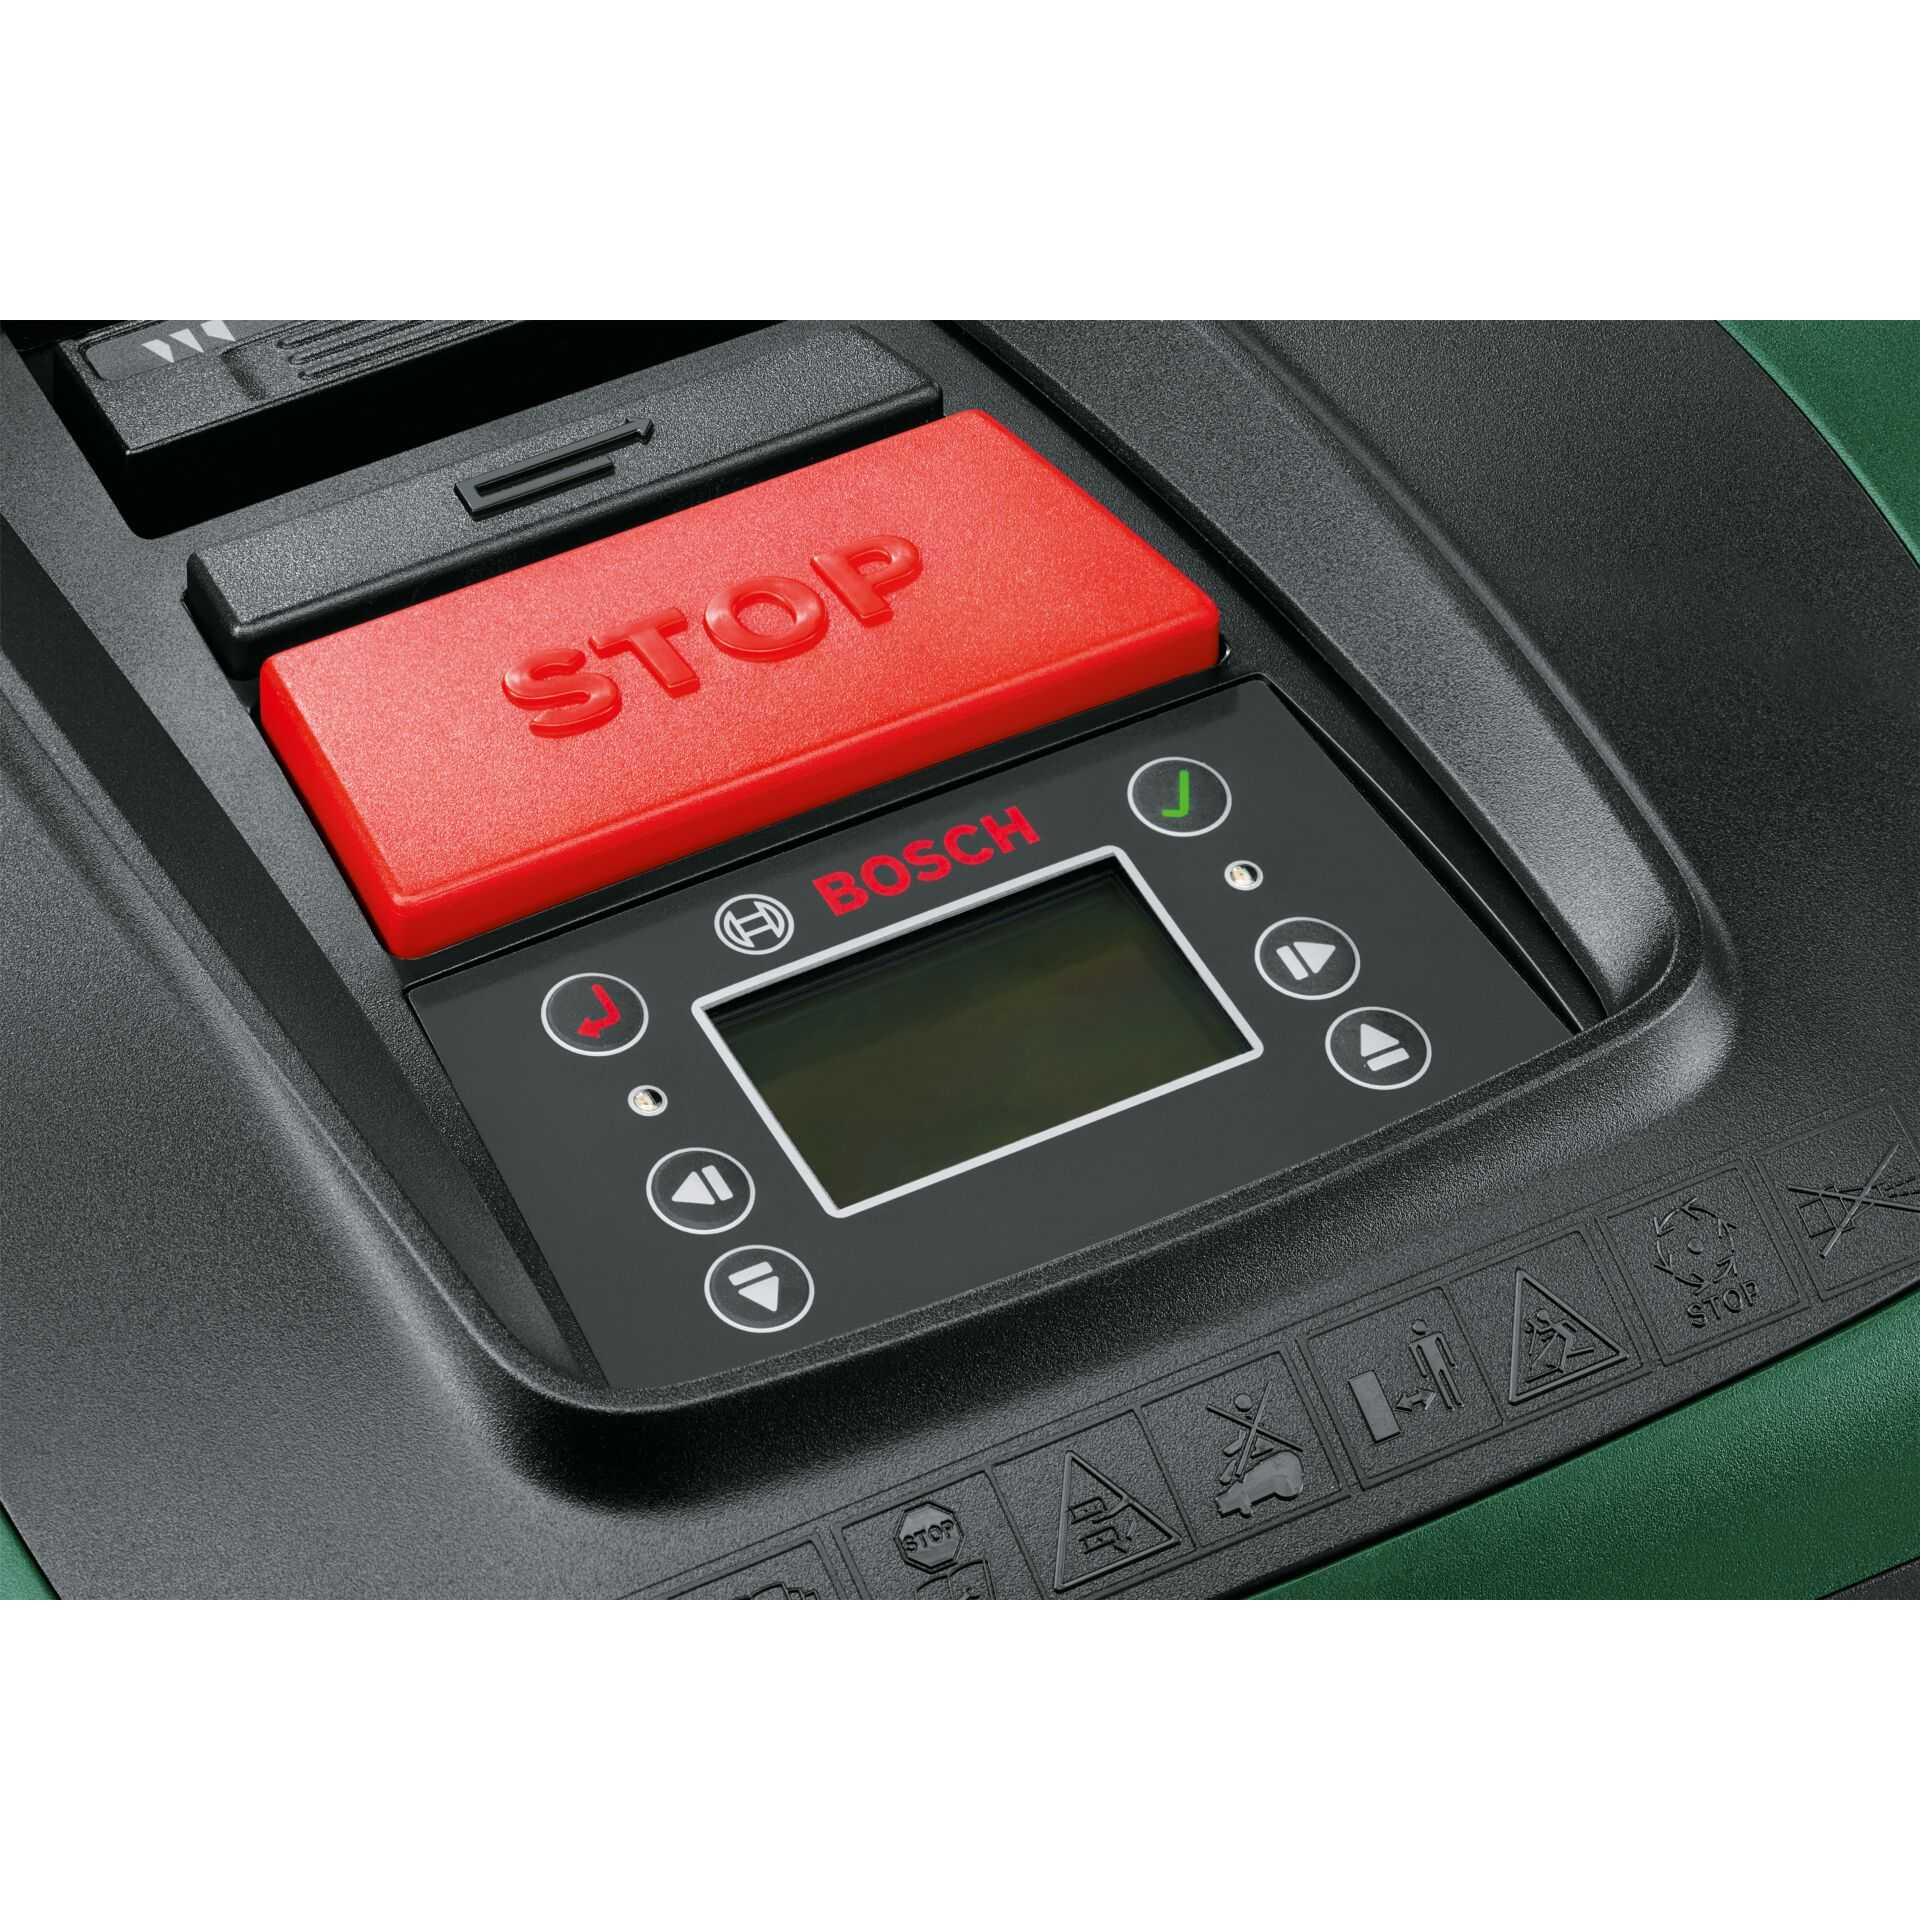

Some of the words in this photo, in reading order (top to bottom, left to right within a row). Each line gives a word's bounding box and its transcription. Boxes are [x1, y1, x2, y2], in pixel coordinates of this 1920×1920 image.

[502, 534, 923, 738] STOP
[811, 805, 1041, 917] BOSCH
[1686, 1279, 1758, 1328] STOP
[902, 1519, 954, 1552] STOP
